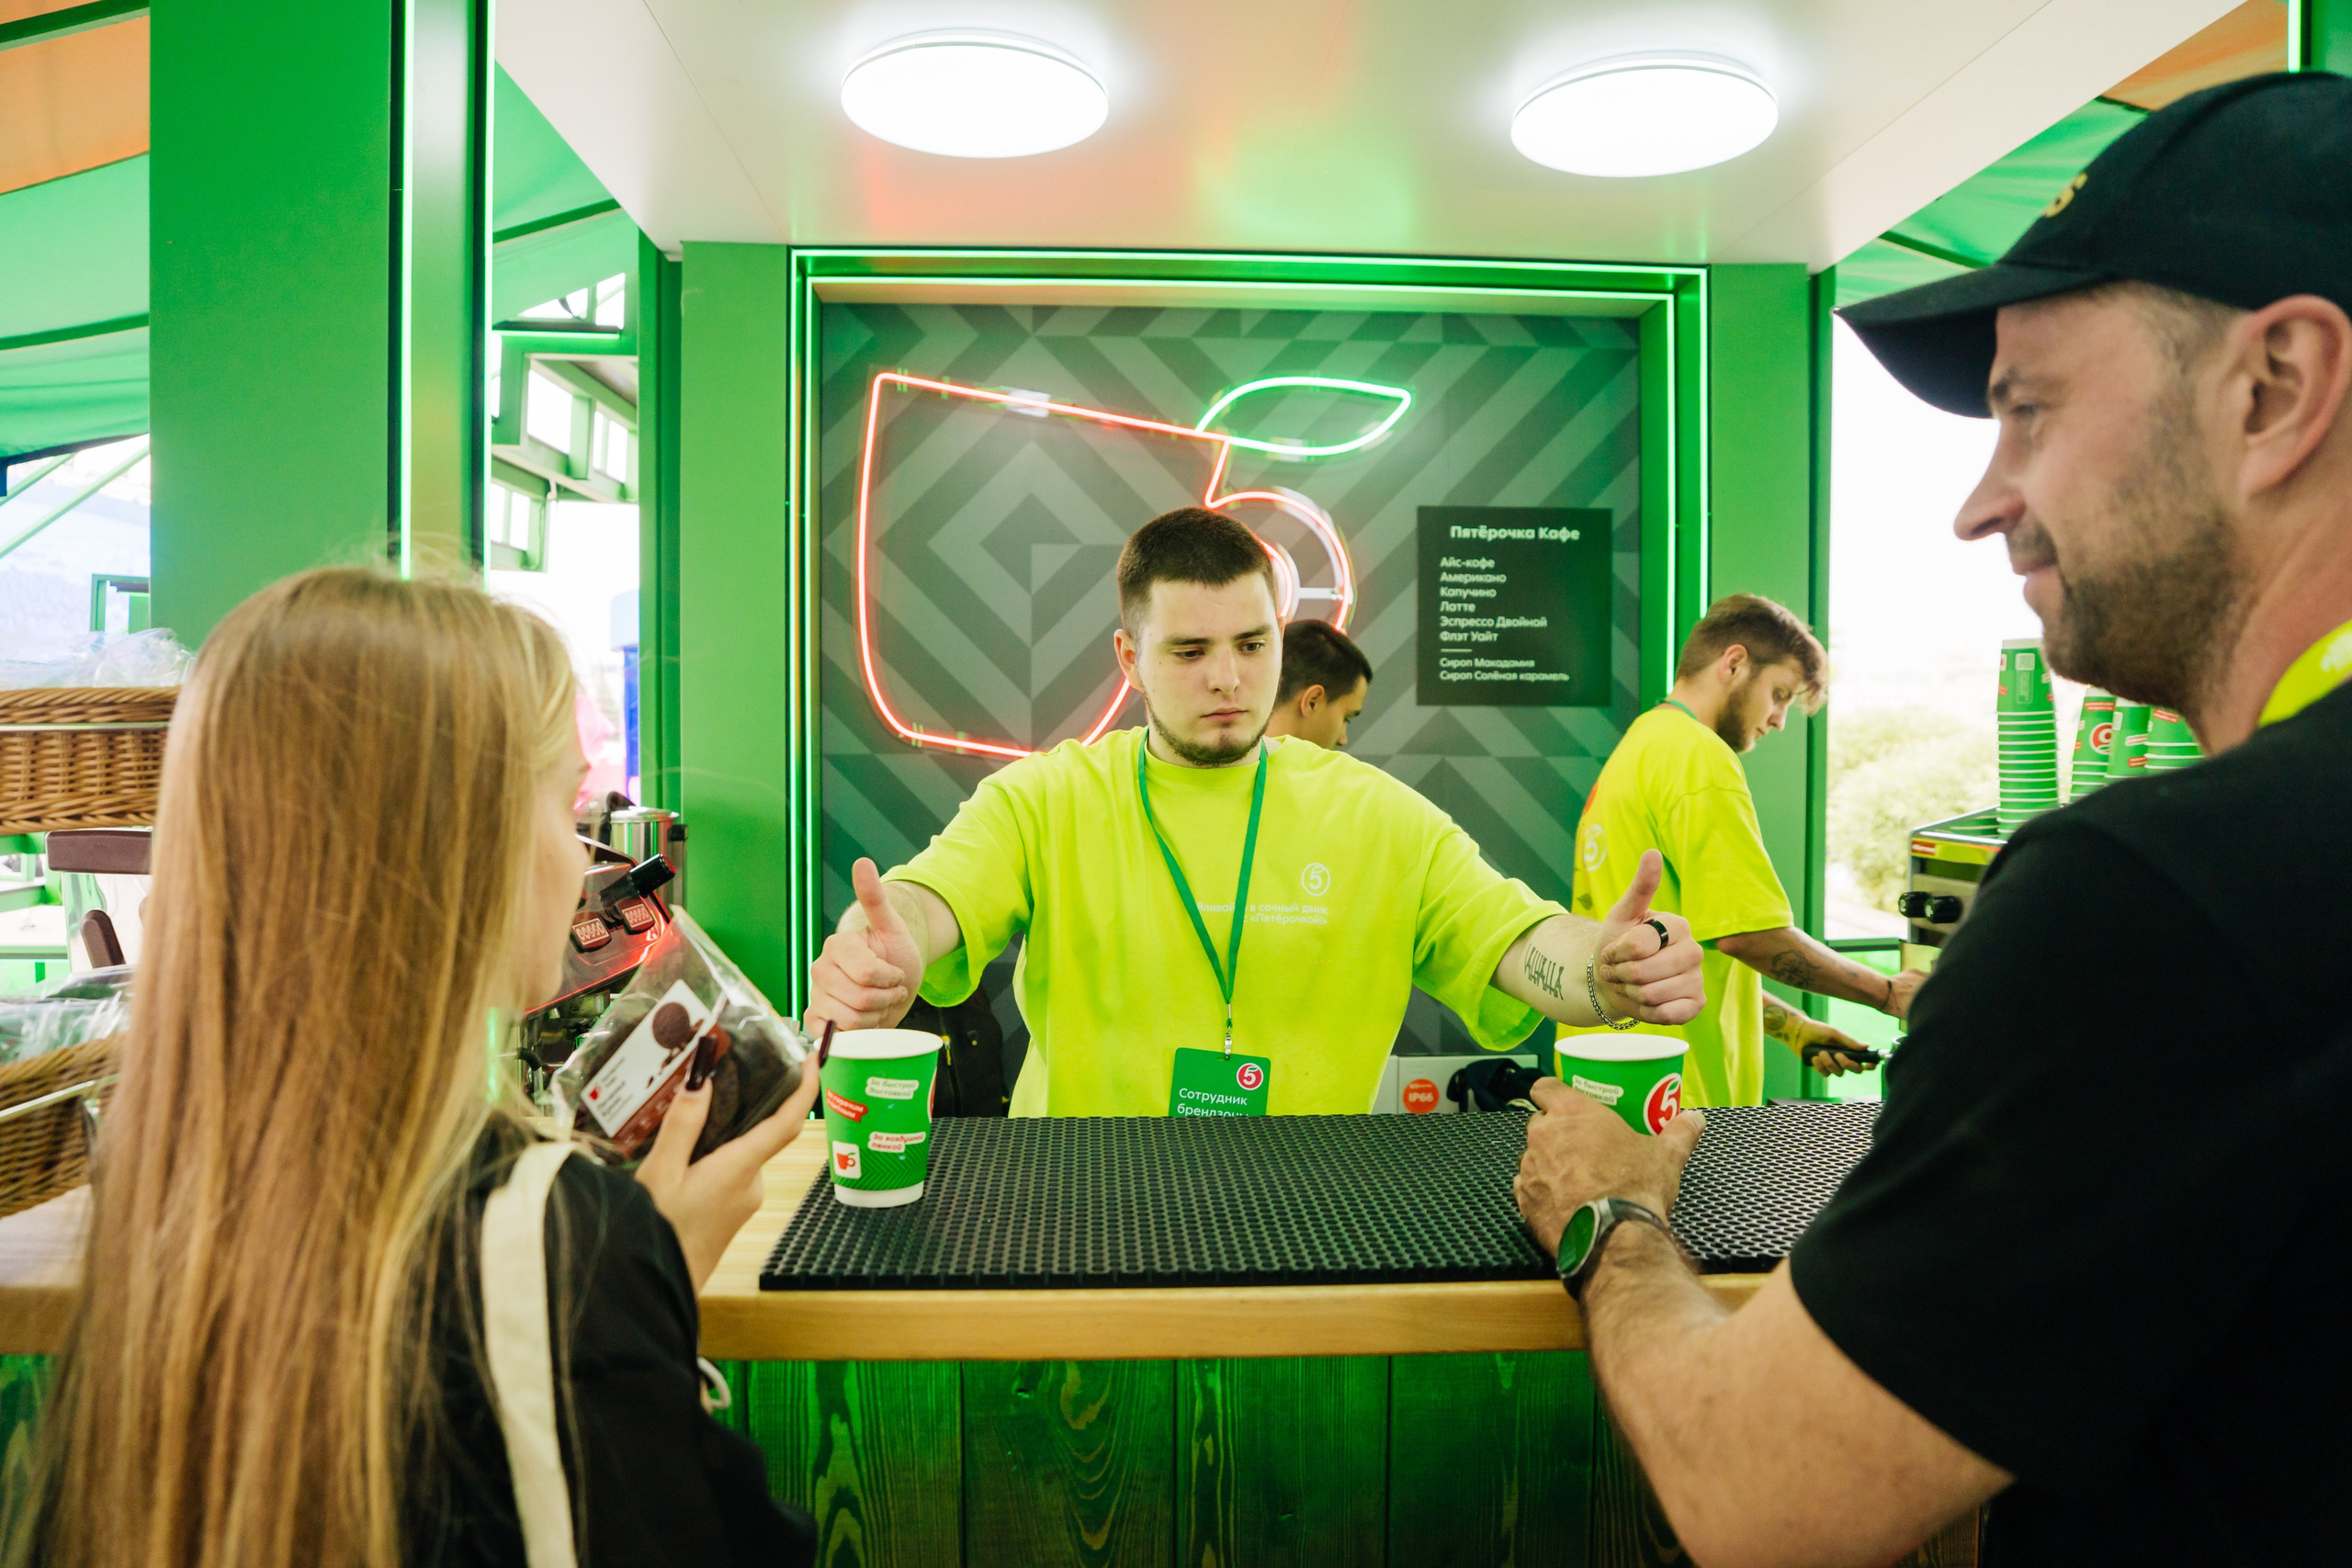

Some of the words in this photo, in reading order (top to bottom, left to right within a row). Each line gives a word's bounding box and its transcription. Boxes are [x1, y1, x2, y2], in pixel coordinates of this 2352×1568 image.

[1450, 524, 1535, 542] Пятёрочка
[1538, 526, 1580, 543] Кафе
[1440, 557, 1495, 570] Айс-кофе
[1440, 571, 1507, 584] Американо
[1440, 586, 1497, 599] Капучино
[1440, 601, 1476, 613] Латте
[1440, 615, 1495, 629] Эспрессо
[1496, 615, 1547, 628] Двойной
[1440, 631, 1469, 642] Флэт
[1471, 631, 1498, 642] Уайт
[1440, 657, 1473, 670] Сироп
[1474, 658, 1535, 669] Макадамия
[1440, 670, 1473, 682] Сироп
[1474, 670, 1518, 681] Солёная
[1519, 672, 1570, 682] карамель
[1250, 904, 1256, 912] в
[1259, 903, 1300, 913] сочный
[1301, 904, 1329, 915] движ
[1179, 1088, 1248, 1106] Сотрудник
[1408, 1092, 1433, 1102] IP66
